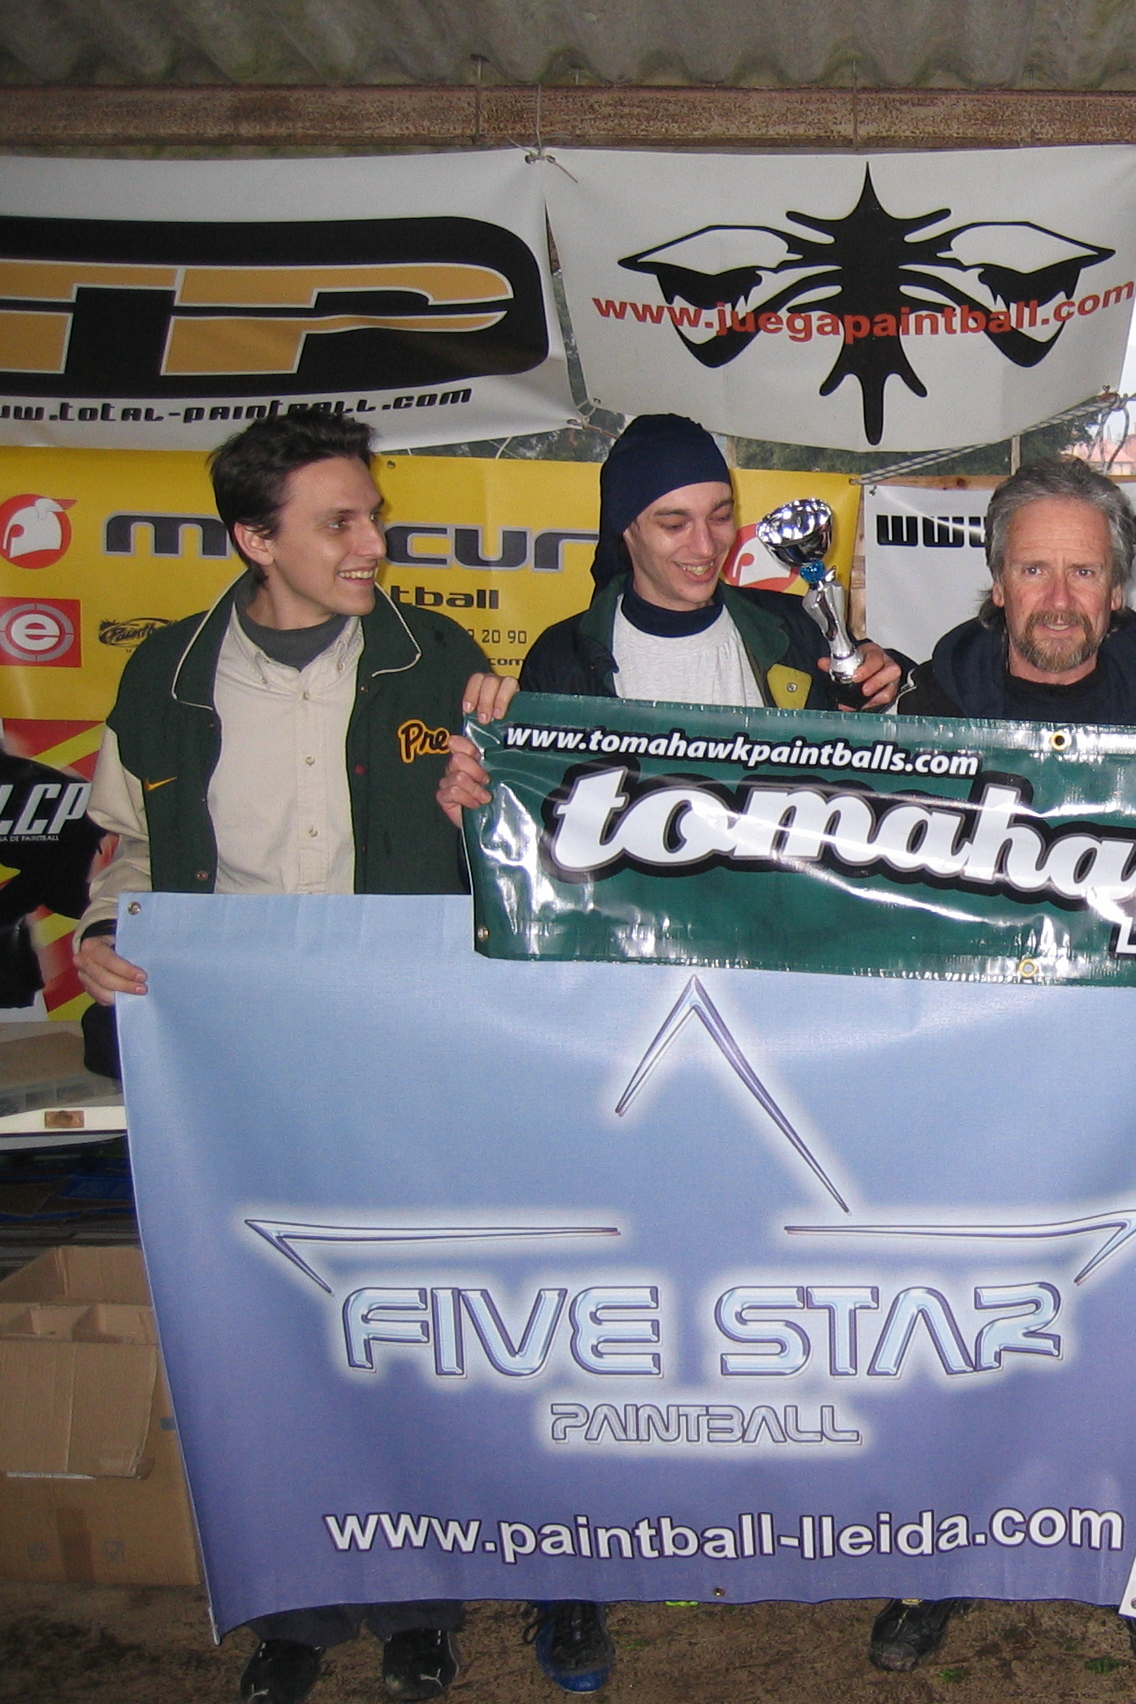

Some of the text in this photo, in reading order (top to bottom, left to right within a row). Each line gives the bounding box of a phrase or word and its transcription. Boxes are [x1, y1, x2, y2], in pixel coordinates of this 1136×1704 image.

[592, 280, 1135, 343] www.juegapaintball.com
[482, 629, 501, 644] 20
[507, 630, 528, 644] 90
[398, 719, 450, 763] Pre
[506, 726, 979, 776] www.tomahawkpaintballs.com
[342, 1282, 1064, 1378] FIVE STAR
[550, 1403, 863, 1446] PAINTBALL
[323, 1506, 1126, 1564] www.paintball-lleida.com
